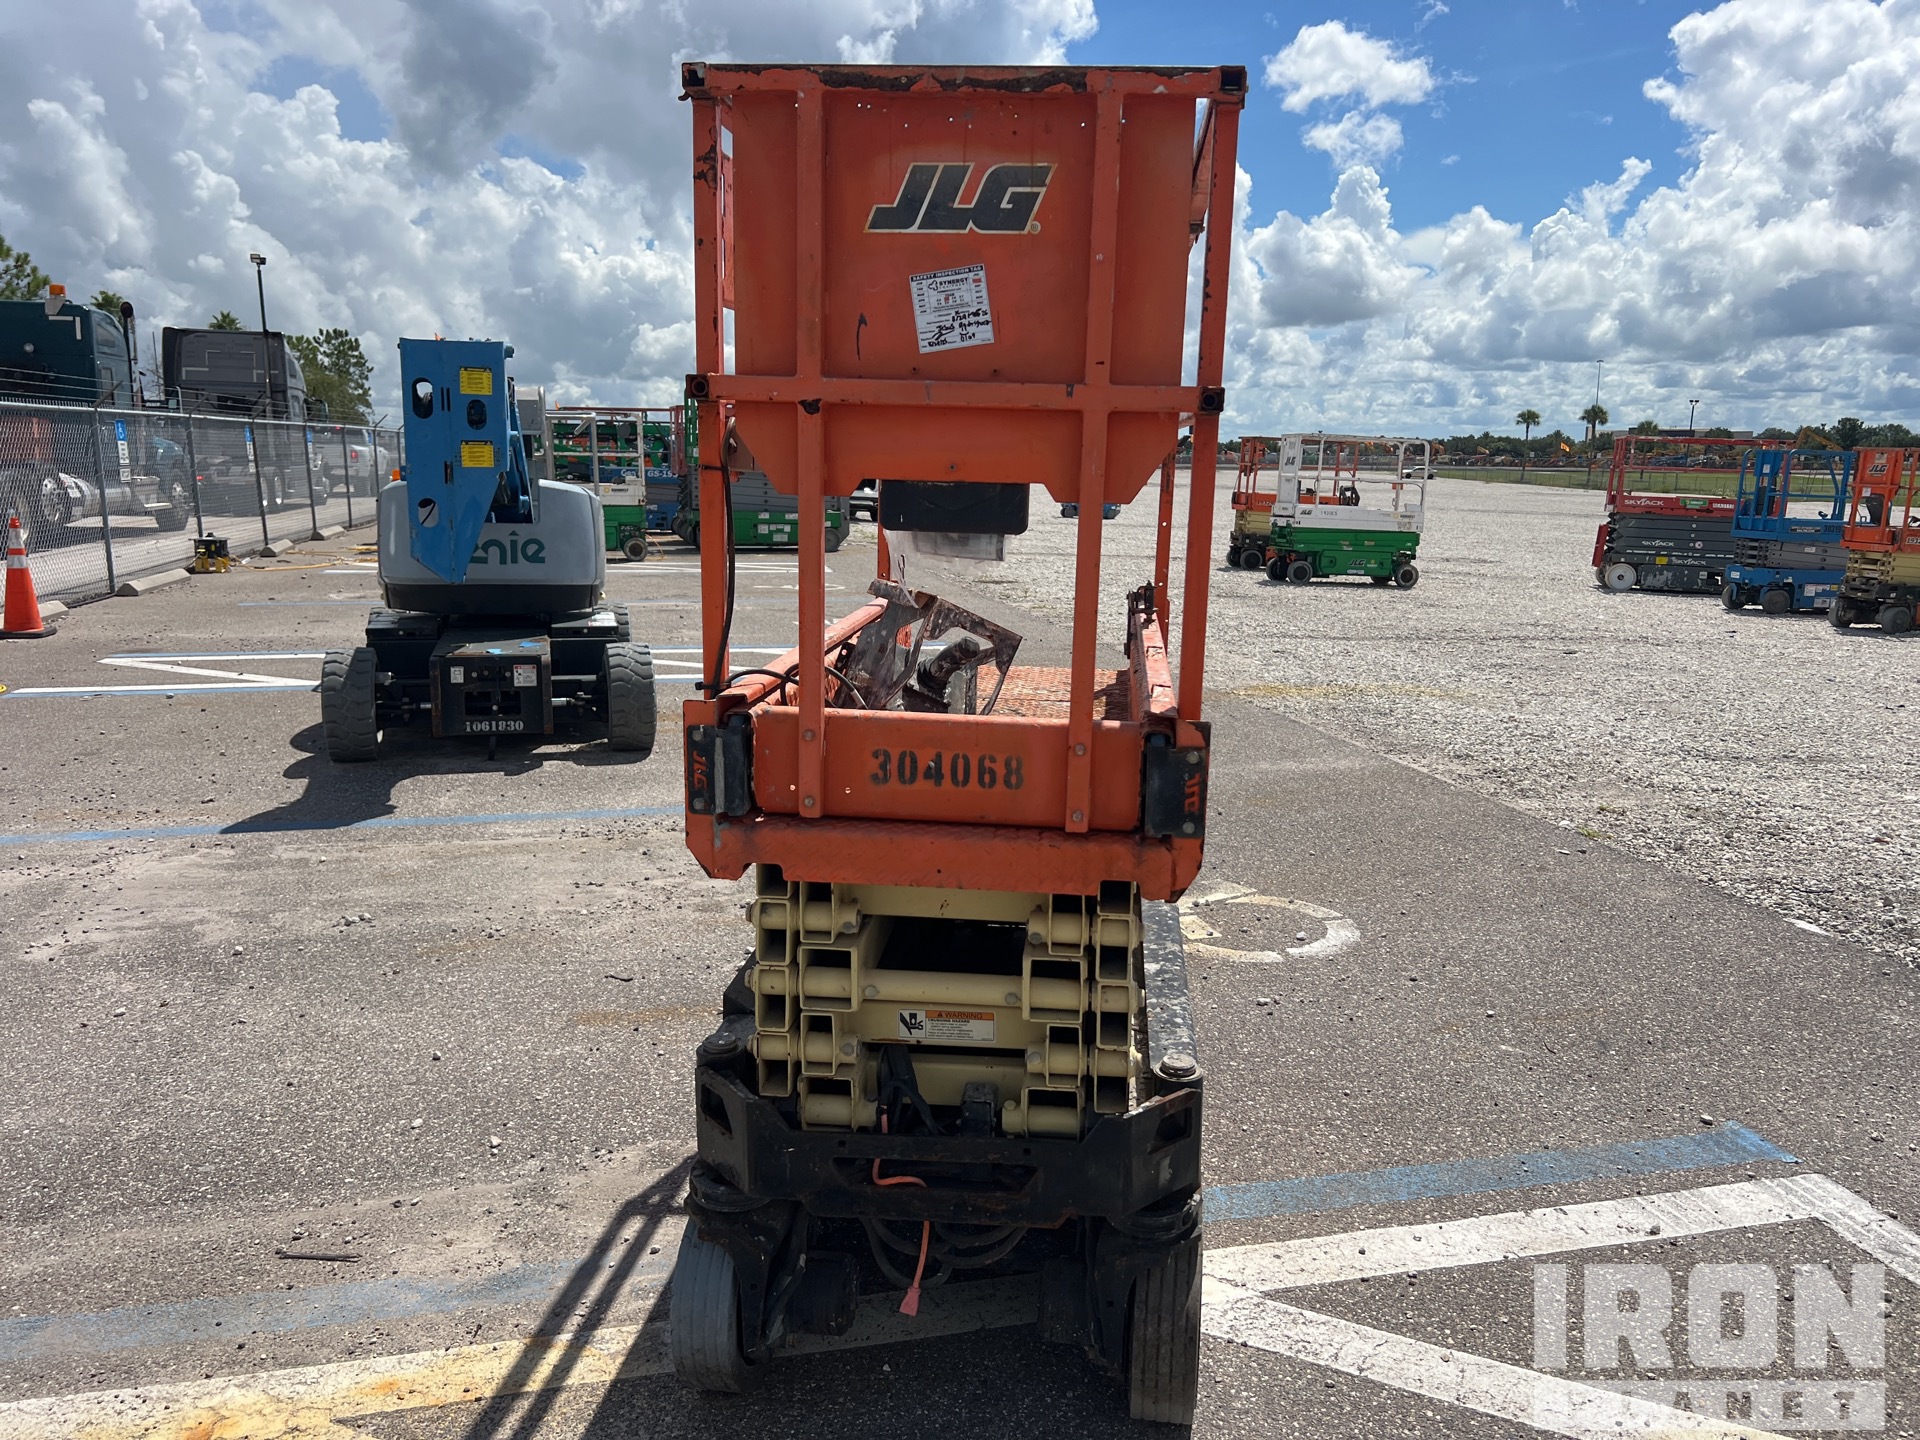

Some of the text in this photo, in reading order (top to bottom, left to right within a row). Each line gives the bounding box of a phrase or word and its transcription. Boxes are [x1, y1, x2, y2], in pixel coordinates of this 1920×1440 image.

[864, 162, 1057, 234] JLG
[912, 273, 935, 281] SAFETY
[935, 268, 969, 277] INSPECTION
[939, 277, 968, 286] SYNERGY
[1867, 463, 1888, 473] JLG
[1624, 497, 1664, 506] SKYJACK
[1349, 559, 1366, 567] JLG
[465, 720, 524, 732] 1061830
[692, 750, 707, 790] JLG
[870, 747, 1025, 790] 304068
[945, 1011, 983, 1020] WARNING
